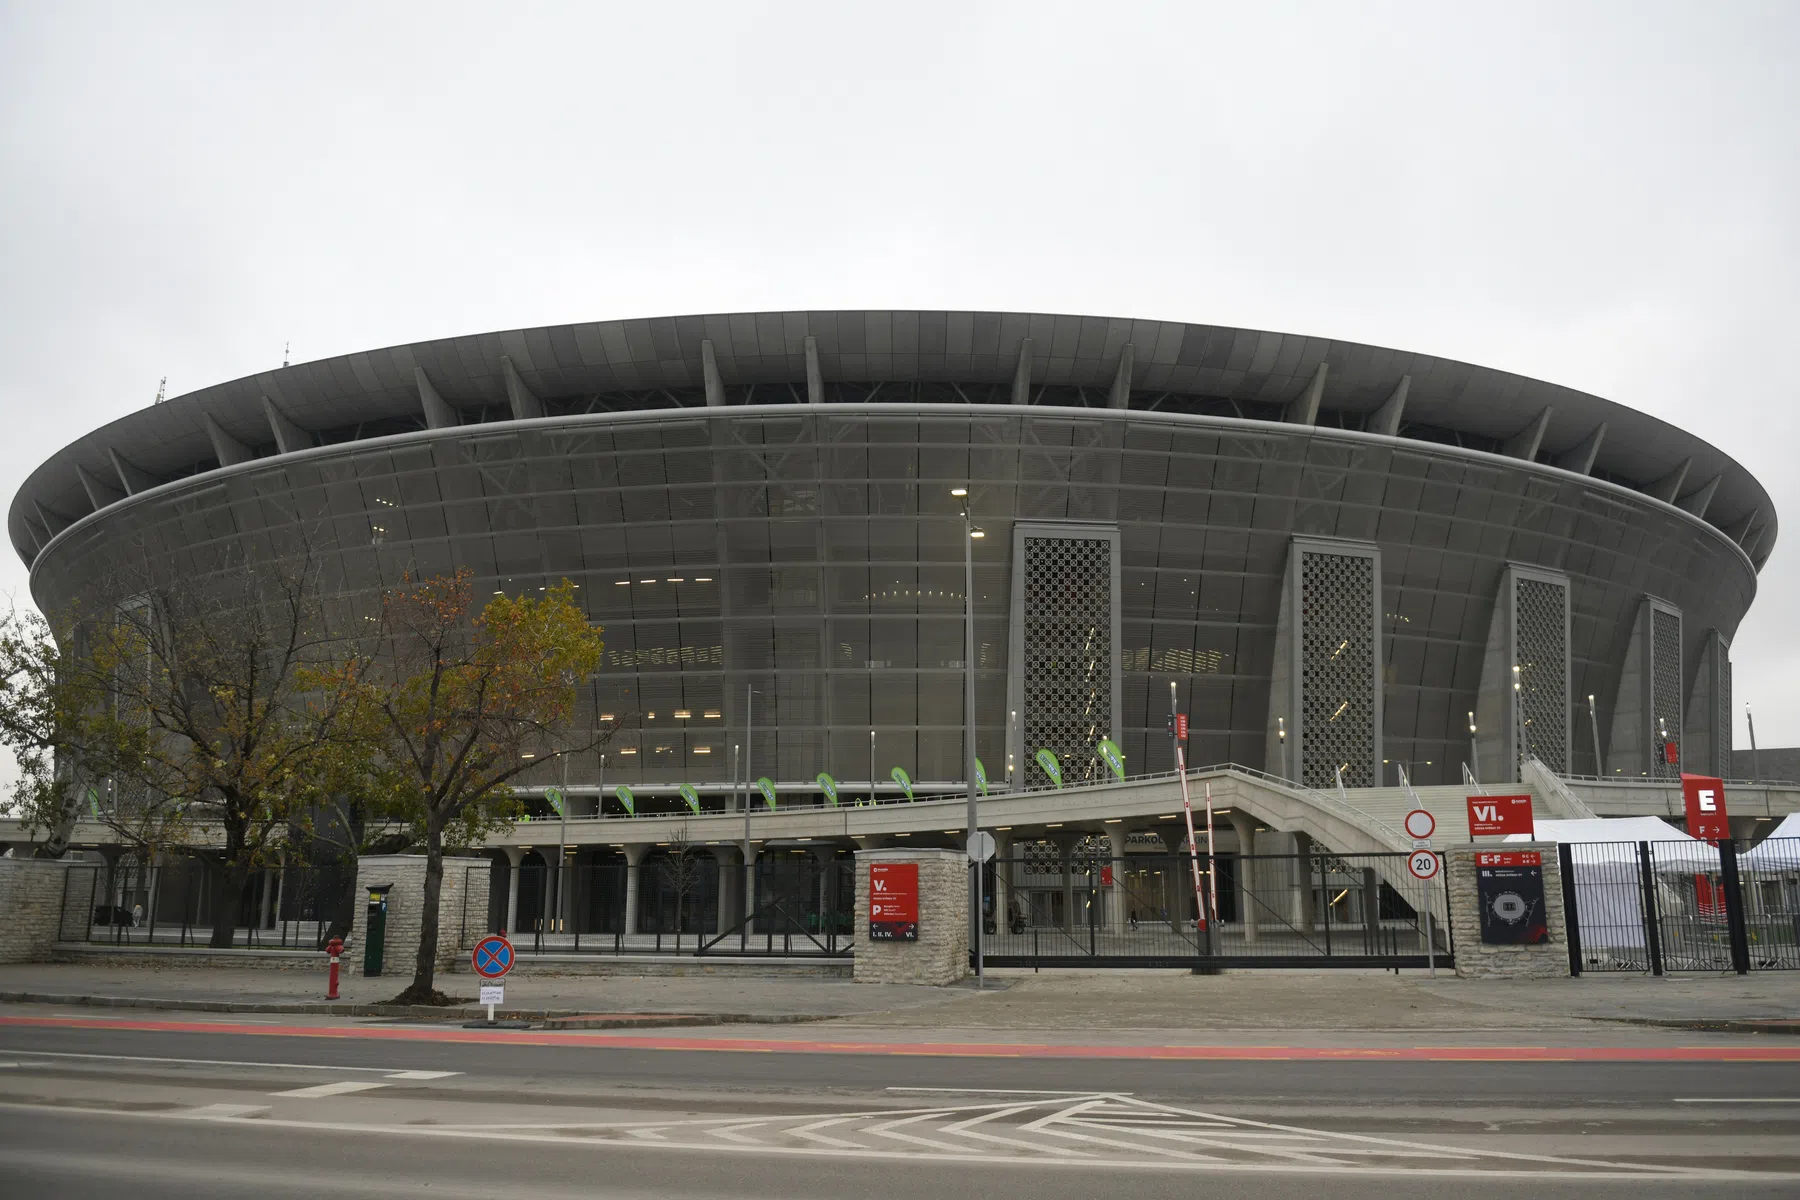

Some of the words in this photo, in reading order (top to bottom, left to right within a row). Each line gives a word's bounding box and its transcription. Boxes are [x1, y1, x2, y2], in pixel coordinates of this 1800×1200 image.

[1698, 790, 1716, 811] E
[1472, 805, 1504, 821] VI.
[1699, 826, 1705, 834] F
[1125, 835, 1163, 844] PARKOL
[1415, 858, 1431, 870] 20
[1481, 855, 1501, 864] E-F
[873, 880, 887, 891] V.
[872, 904, 882, 915] P
